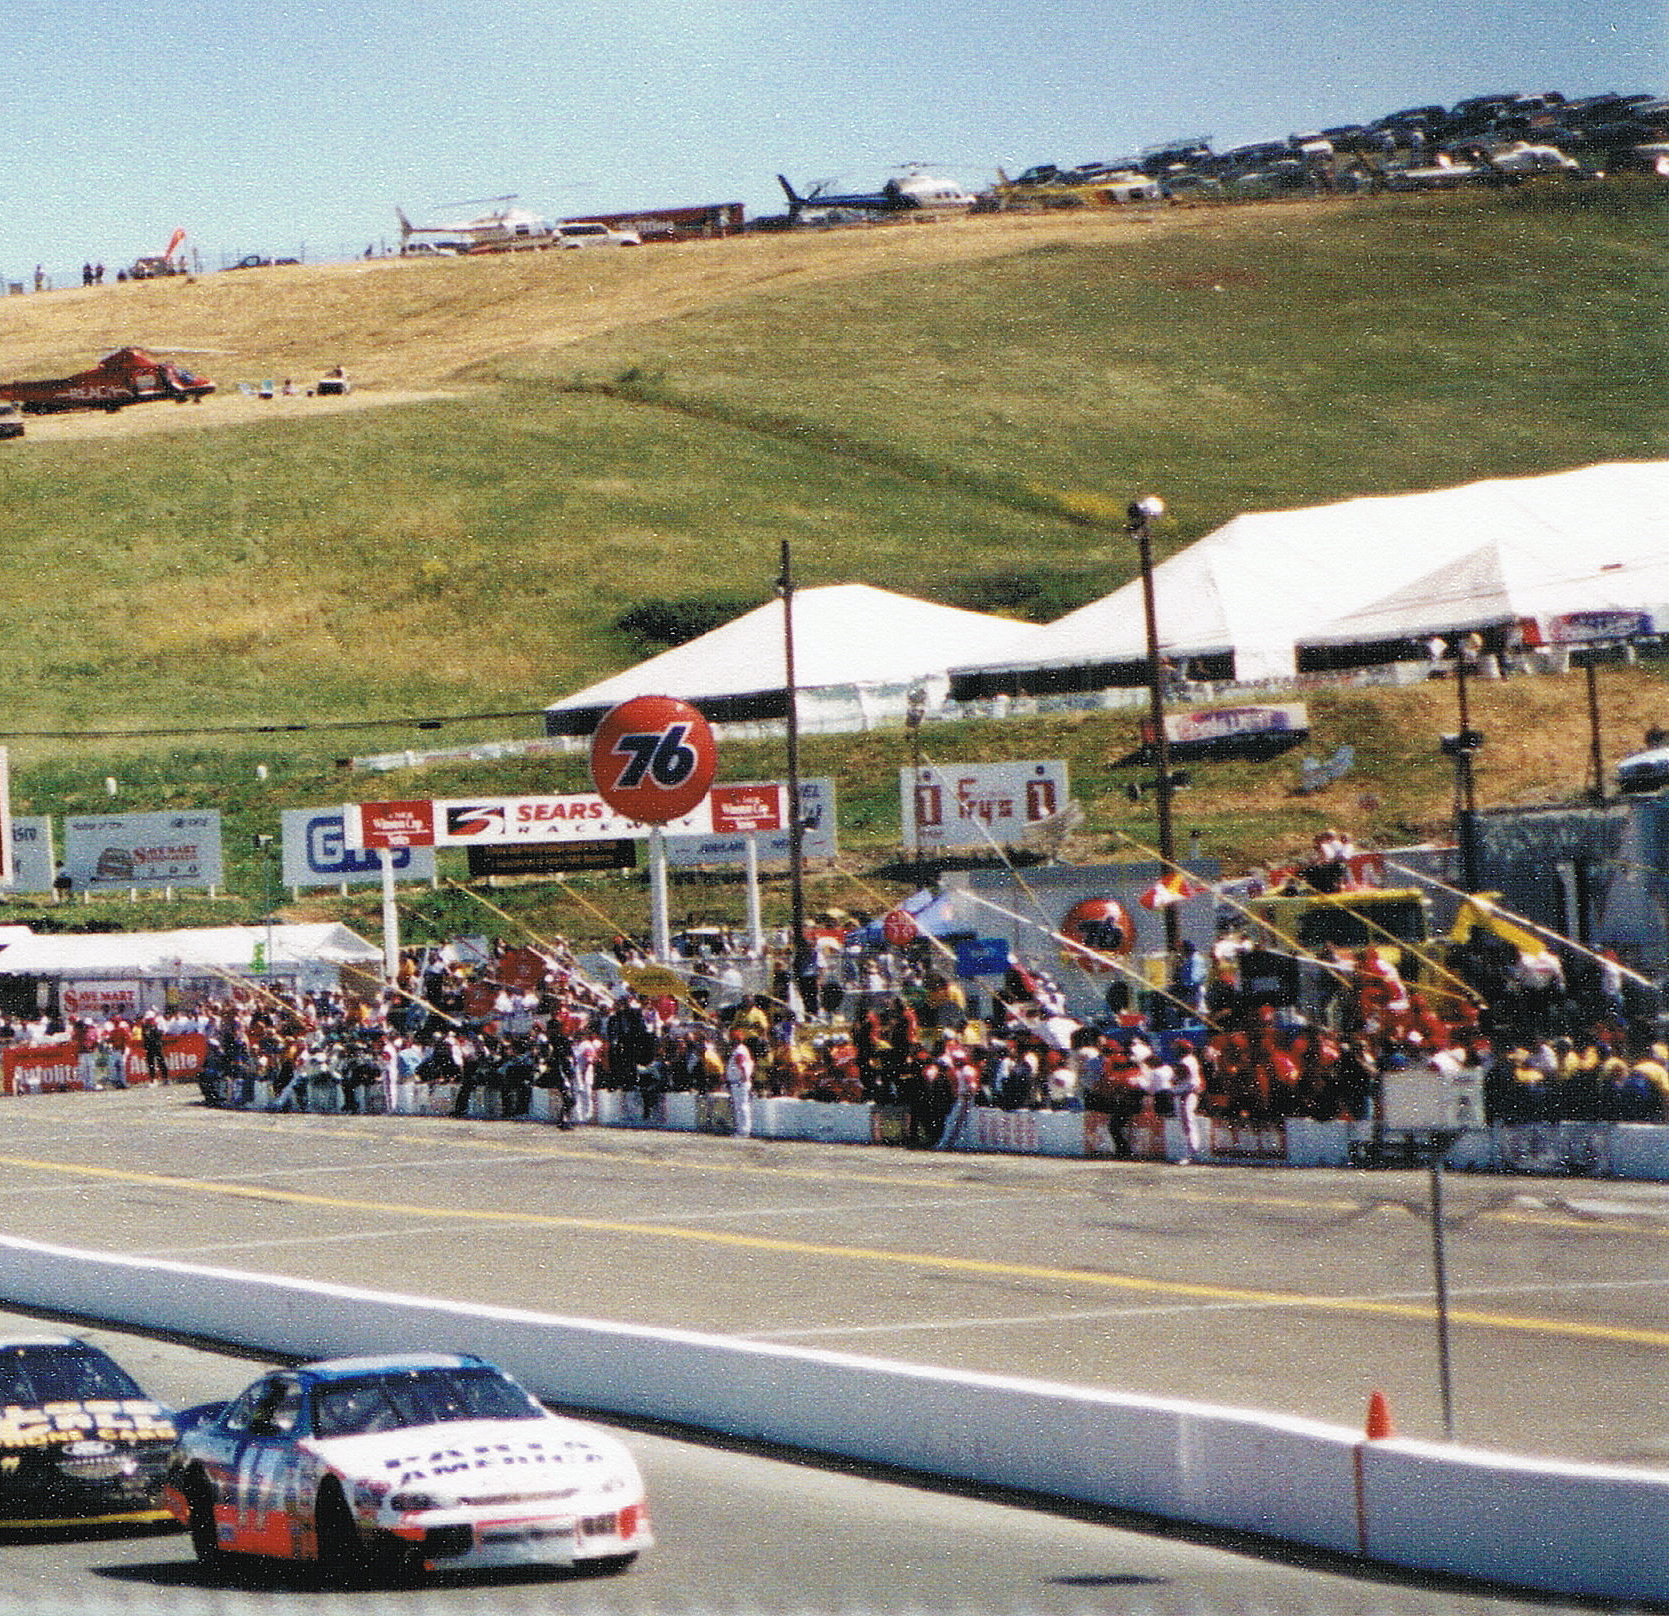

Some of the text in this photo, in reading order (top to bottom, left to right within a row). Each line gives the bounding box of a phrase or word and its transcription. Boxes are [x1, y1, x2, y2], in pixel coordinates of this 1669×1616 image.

[610, 722, 697, 790] 76
[516, 802, 603, 822] SEARS
[517, 818, 692, 834] RACEWY
[384, 1442, 590, 1469] PARTS
[400, 1453, 604, 1487] AMERICA
